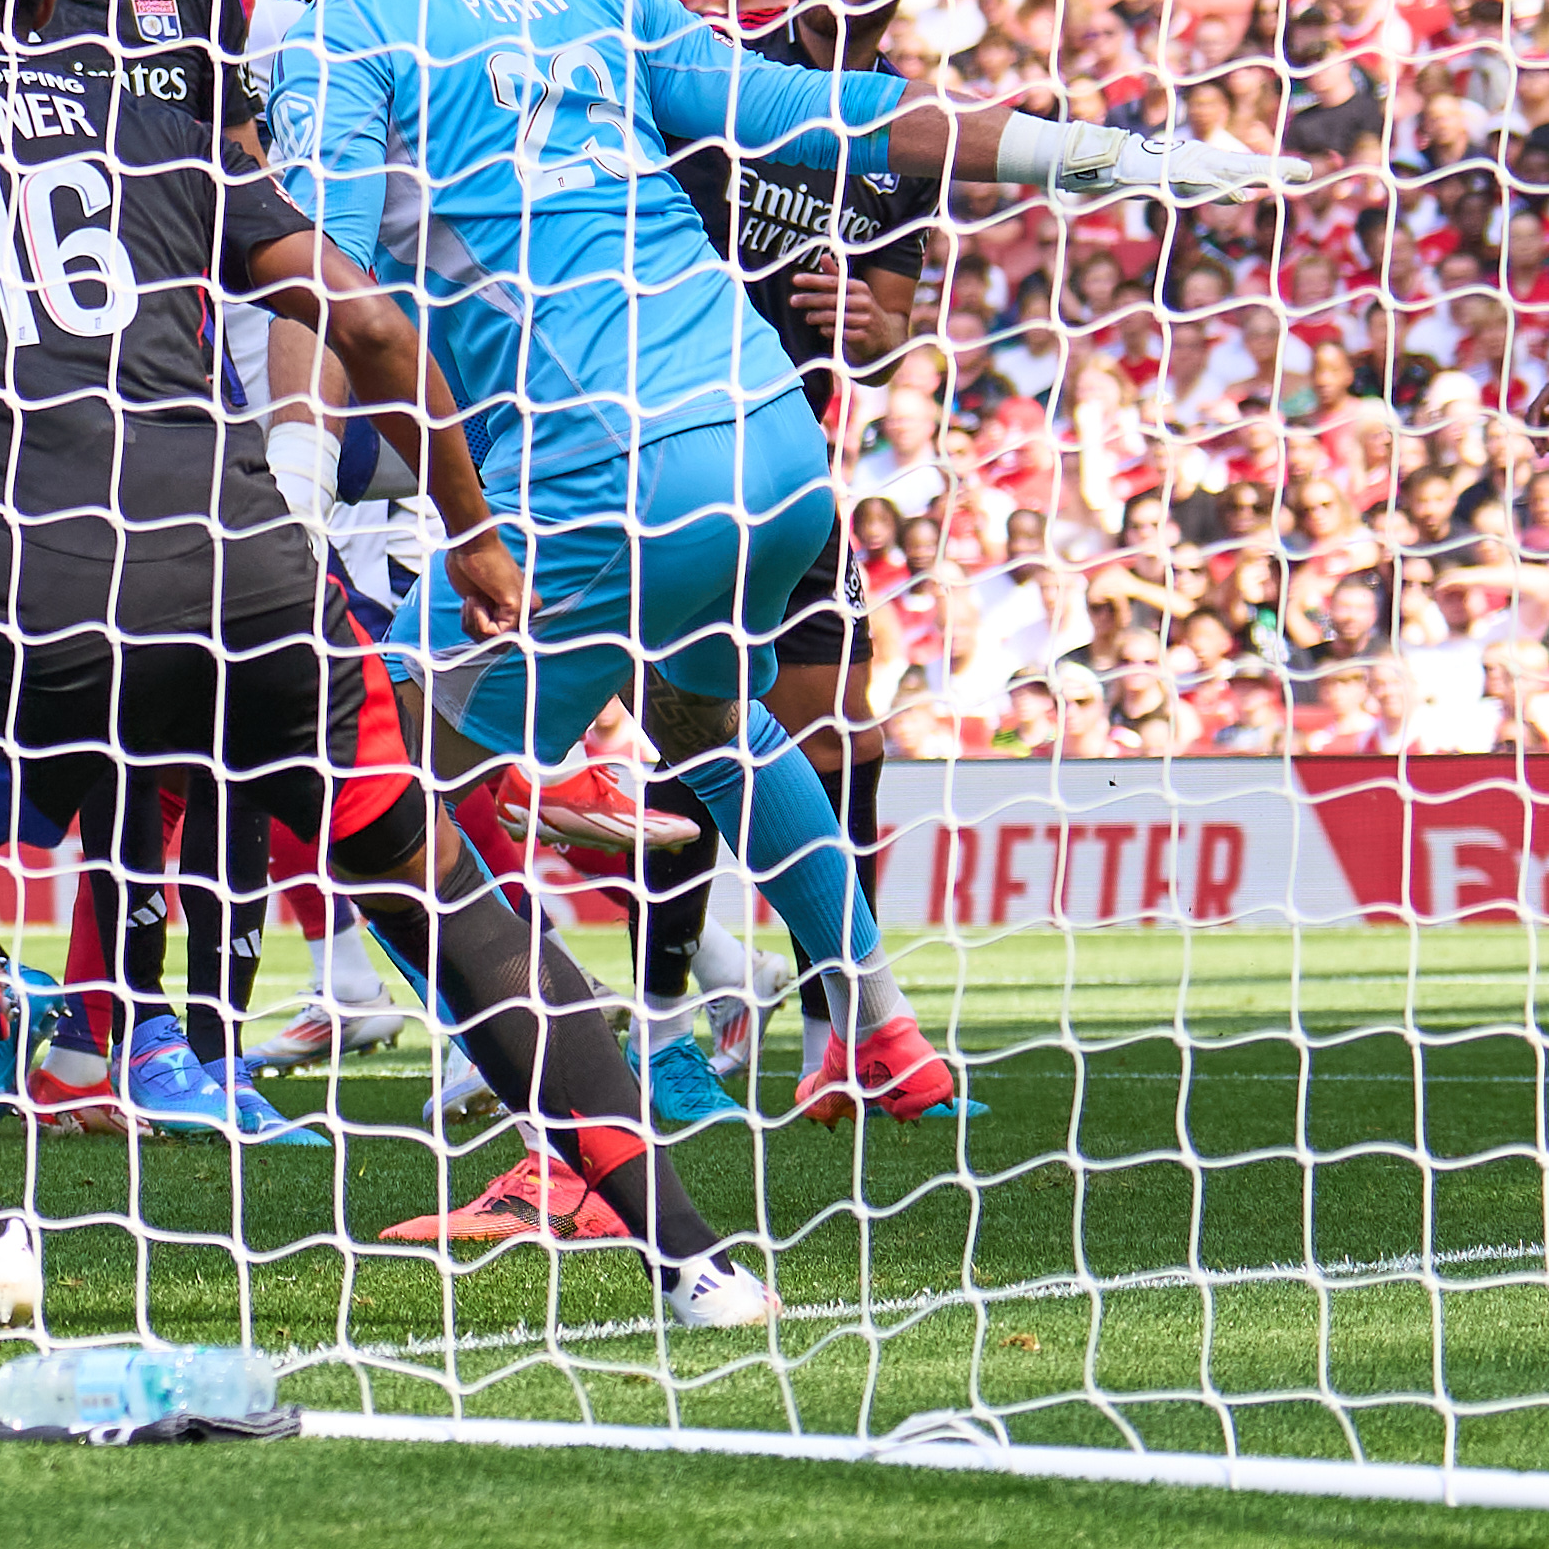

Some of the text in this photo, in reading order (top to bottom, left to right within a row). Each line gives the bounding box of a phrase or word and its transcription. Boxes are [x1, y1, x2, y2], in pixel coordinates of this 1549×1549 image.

[141, 15, 178, 37] OL
[486, 44, 657, 202] 23
[726, 165, 882, 243] Emirates
[739, 217, 784, 253] FLY
[926, 821, 1248, 925] BETTER
